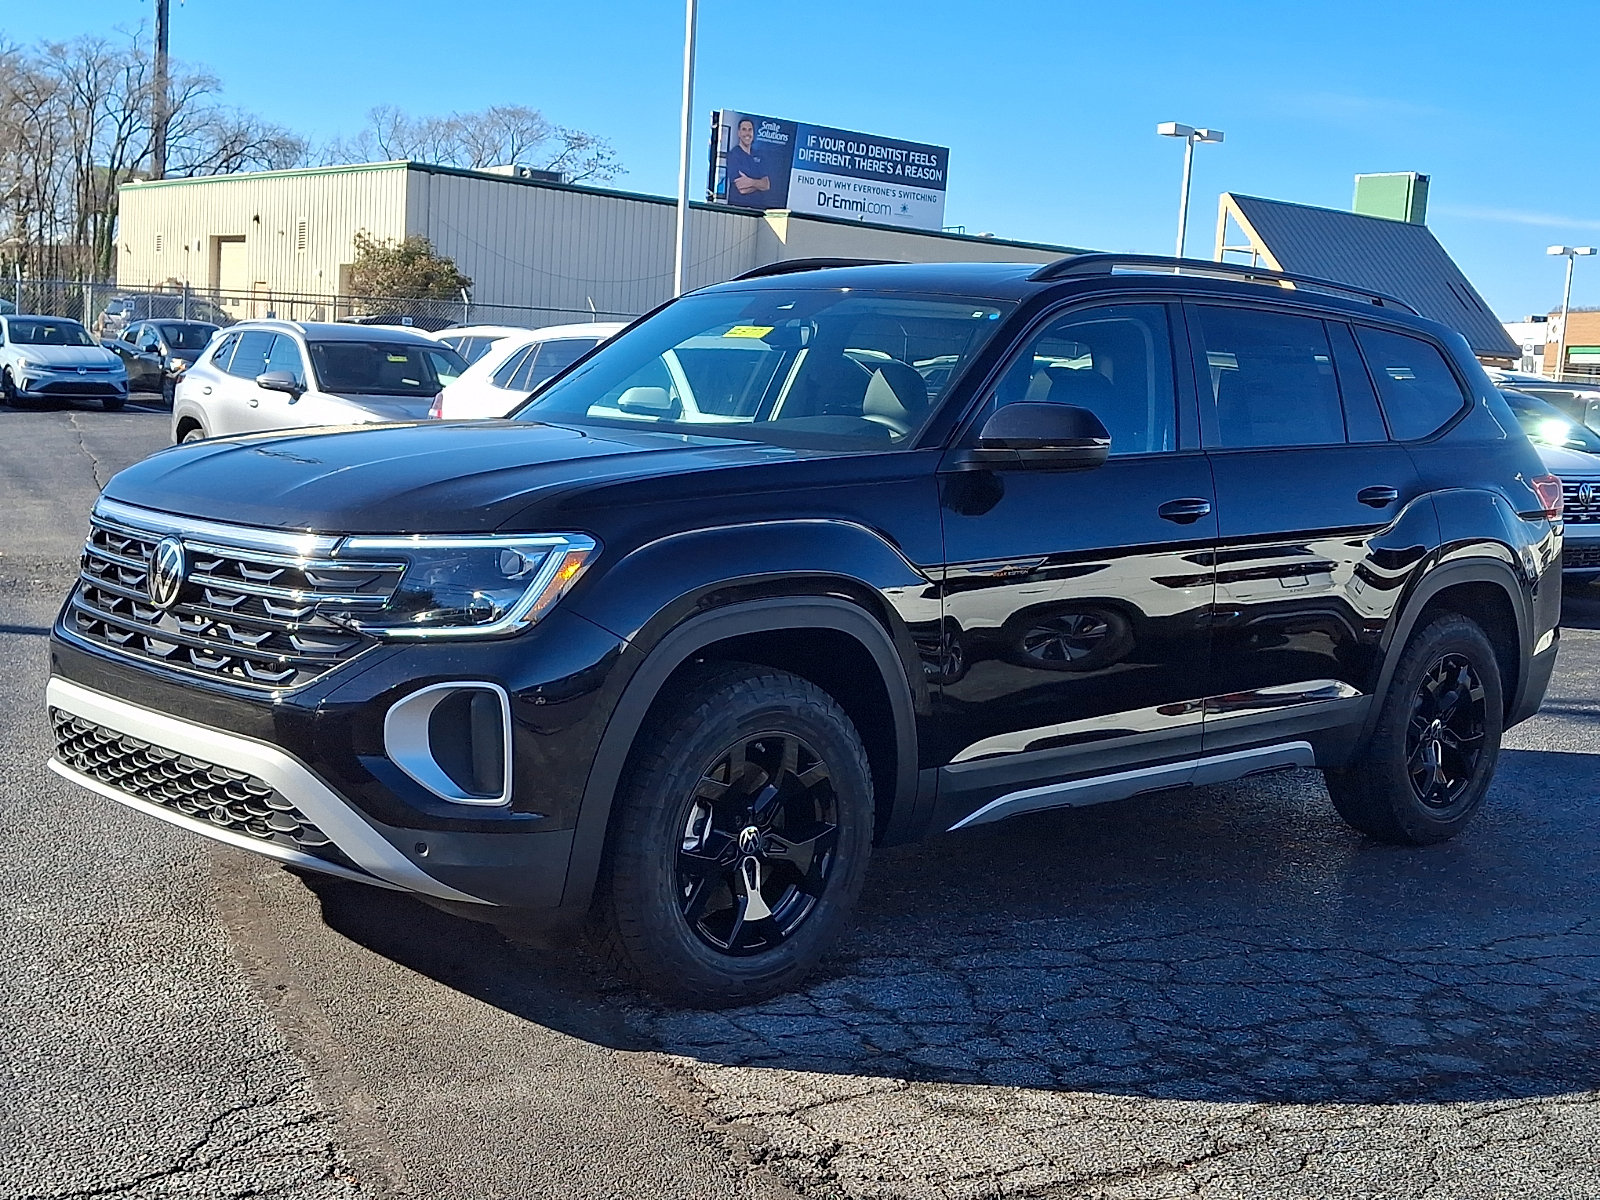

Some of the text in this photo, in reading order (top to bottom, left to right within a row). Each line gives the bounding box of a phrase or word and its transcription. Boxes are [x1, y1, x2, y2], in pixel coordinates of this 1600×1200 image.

[757, 128, 789, 142] Solutions
[761, 121, 781, 132] Smile
[807, 134, 938, 167] IF YOUR OLD DENTIST FEELS
[798, 148, 943, 181] DIFFERENT, THERE'S A REASON
[797, 175, 937, 203] FIND OUT WHY EVERYONE'S SWITCHING
[817, 191, 892, 216] DrEmmi.com
